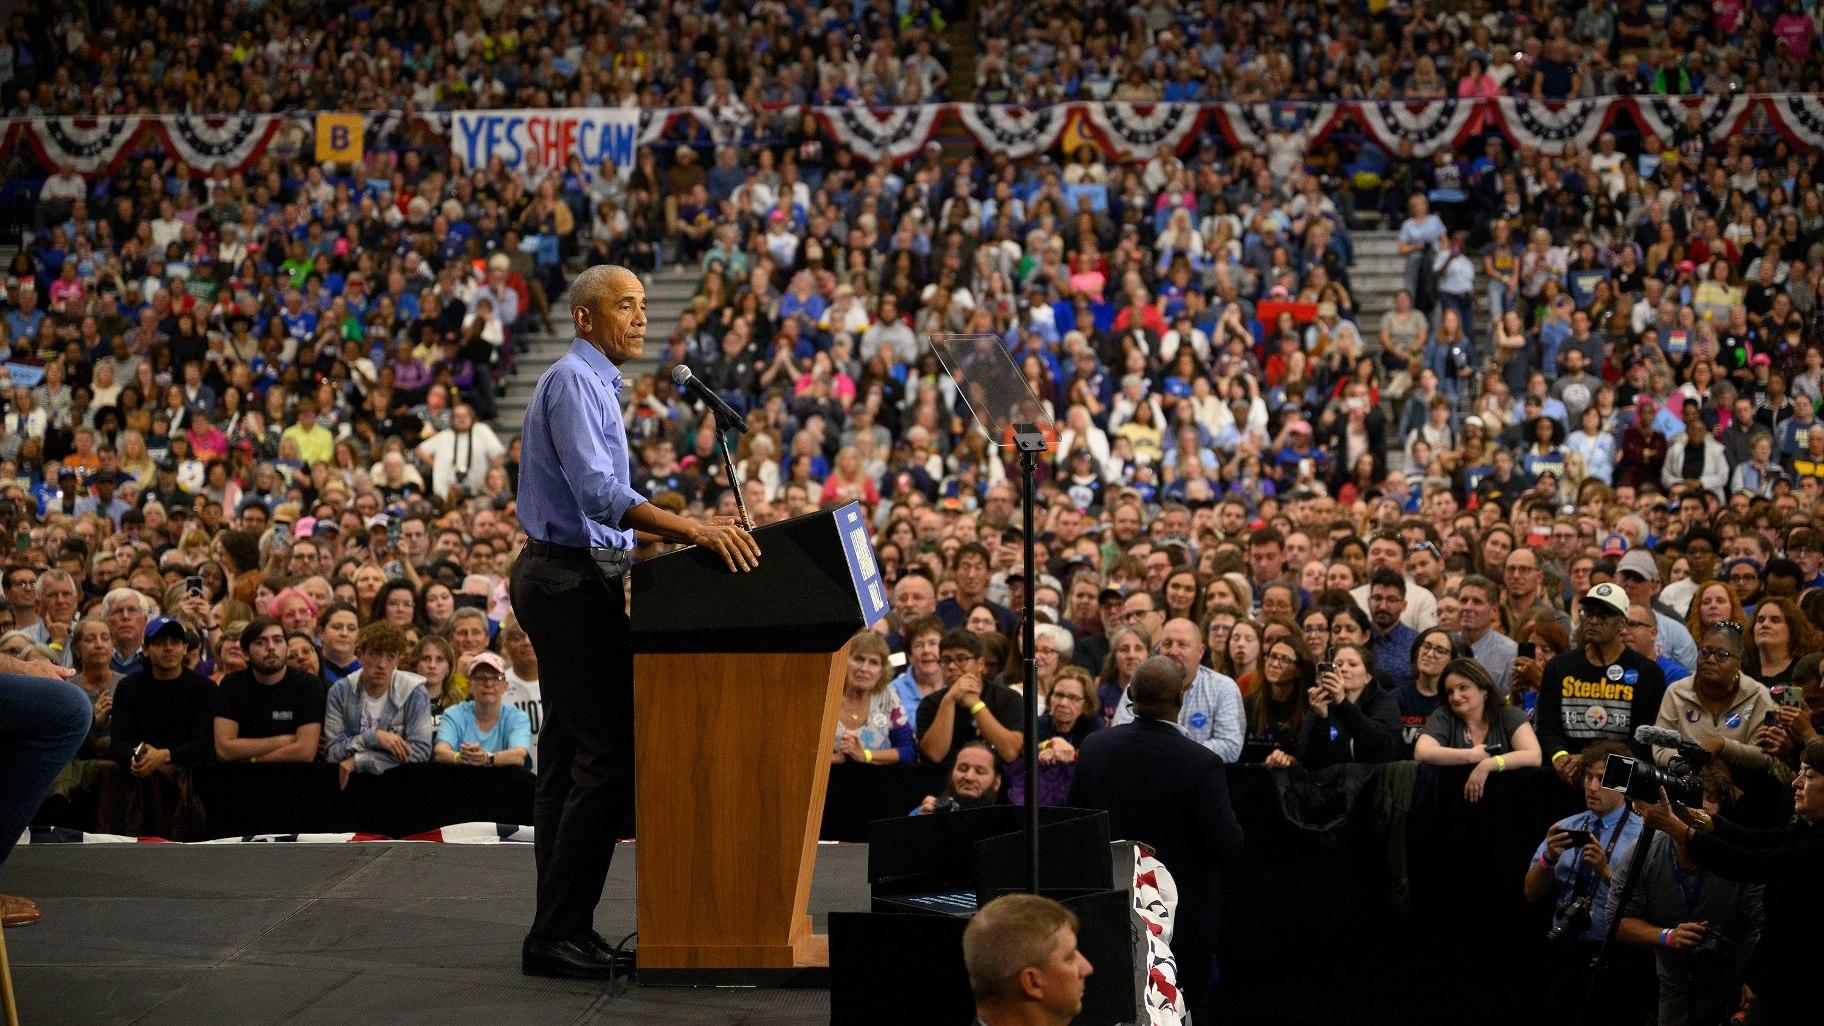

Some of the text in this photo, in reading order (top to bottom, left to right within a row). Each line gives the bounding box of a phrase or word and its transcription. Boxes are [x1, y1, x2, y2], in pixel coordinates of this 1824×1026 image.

[331, 125, 349, 151] B
[458, 115, 635, 171] YES SHE CAN
[1562, 675, 1634, 701] Steelers
